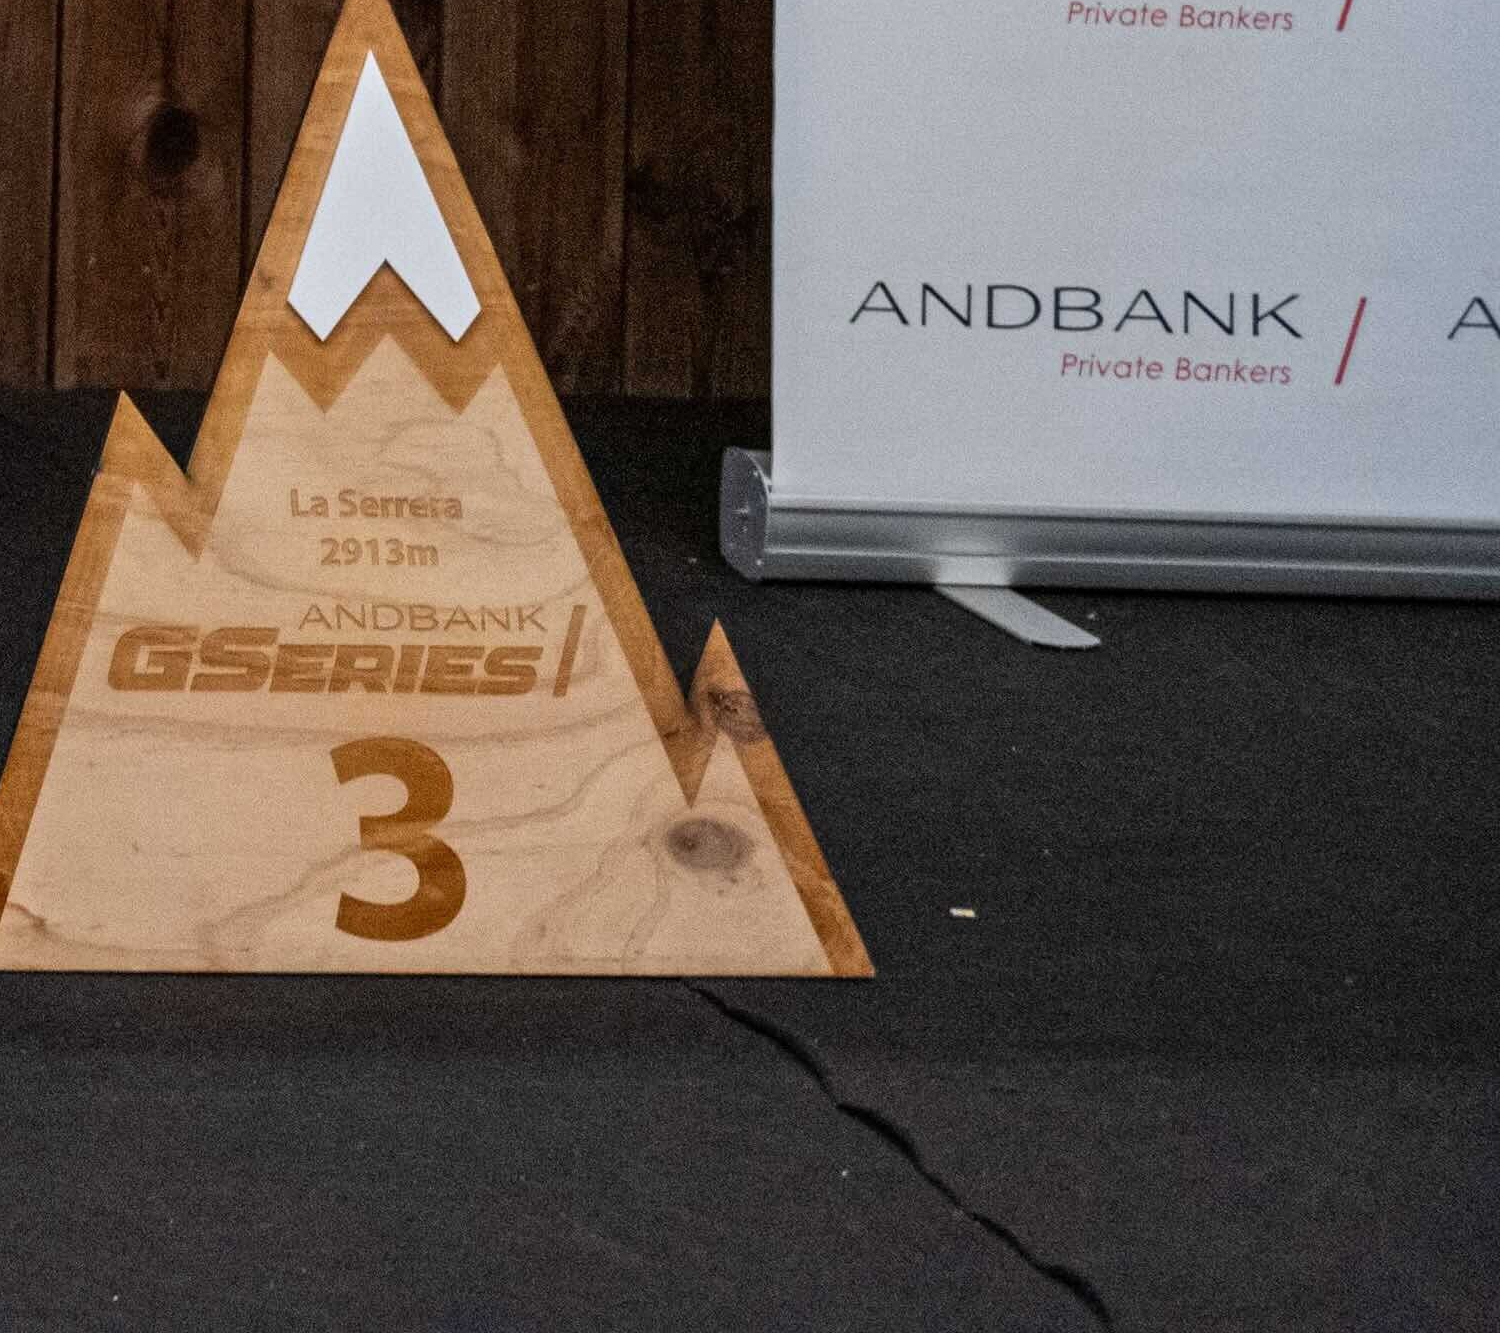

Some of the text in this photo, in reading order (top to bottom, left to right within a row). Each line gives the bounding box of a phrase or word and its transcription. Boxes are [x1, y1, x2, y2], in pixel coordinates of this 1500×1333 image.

[1067, 1, 1295, 32] Private Bankers
[849, 281, 1303, 339] ANDBANK
[1060, 353, 1292, 386] Private Bankers
[290, 488, 463, 521] La Serrera
[319, 537, 439, 567] 2913m
[298, 603, 547, 633] ANDBANK
[107, 625, 544, 696] GSERIES
[330, 735, 467, 943] 3
